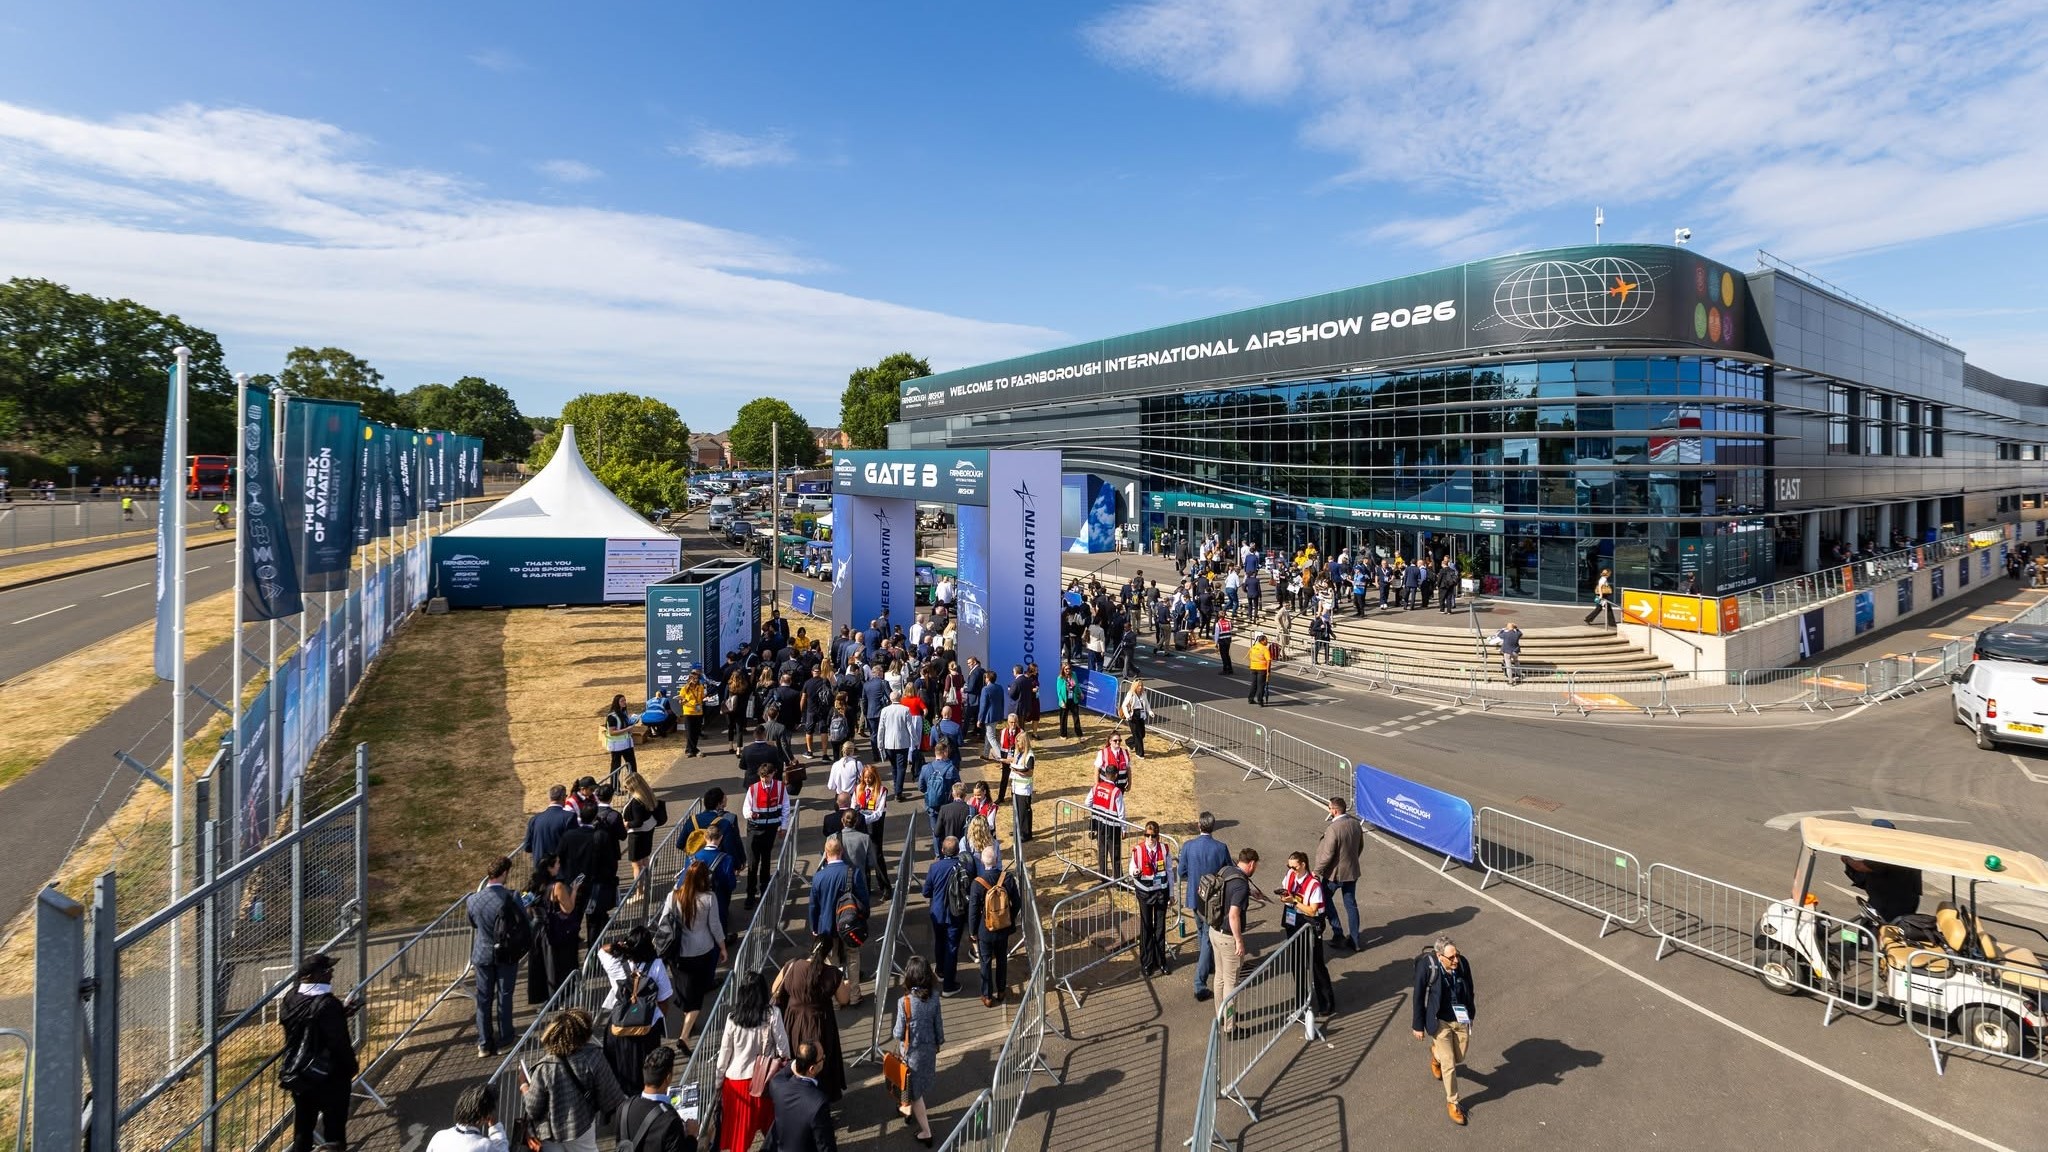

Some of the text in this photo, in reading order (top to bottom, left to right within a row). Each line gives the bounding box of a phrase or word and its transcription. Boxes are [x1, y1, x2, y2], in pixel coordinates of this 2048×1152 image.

[950, 300, 1456, 397] WELCOME TO FARNBOROUGH INTERNATIONAL AIRSHOW 2026
[316, 447, 332, 518] AVIATION
[864, 462, 938, 488] GATE B
[949, 469, 984, 478] FARNBOROUGH
[305, 456, 319, 533] THE APEX
[1124, 482, 1135, 519] 1
[1774, 478, 1801, 501] 1 EAST
[1177, 500, 1234, 509] SHOW ENTRANCE
[1351, 510, 1442, 521] SHOW ENTRANCE
[315, 522, 326, 543] OF
[1124, 523, 1140, 532] EAST
[881, 527, 891, 577] MARTIN
[1024, 509, 1036, 666] OCKHEED MARTIN
[1386, 797, 1431, 820] FARNBOROUGH
